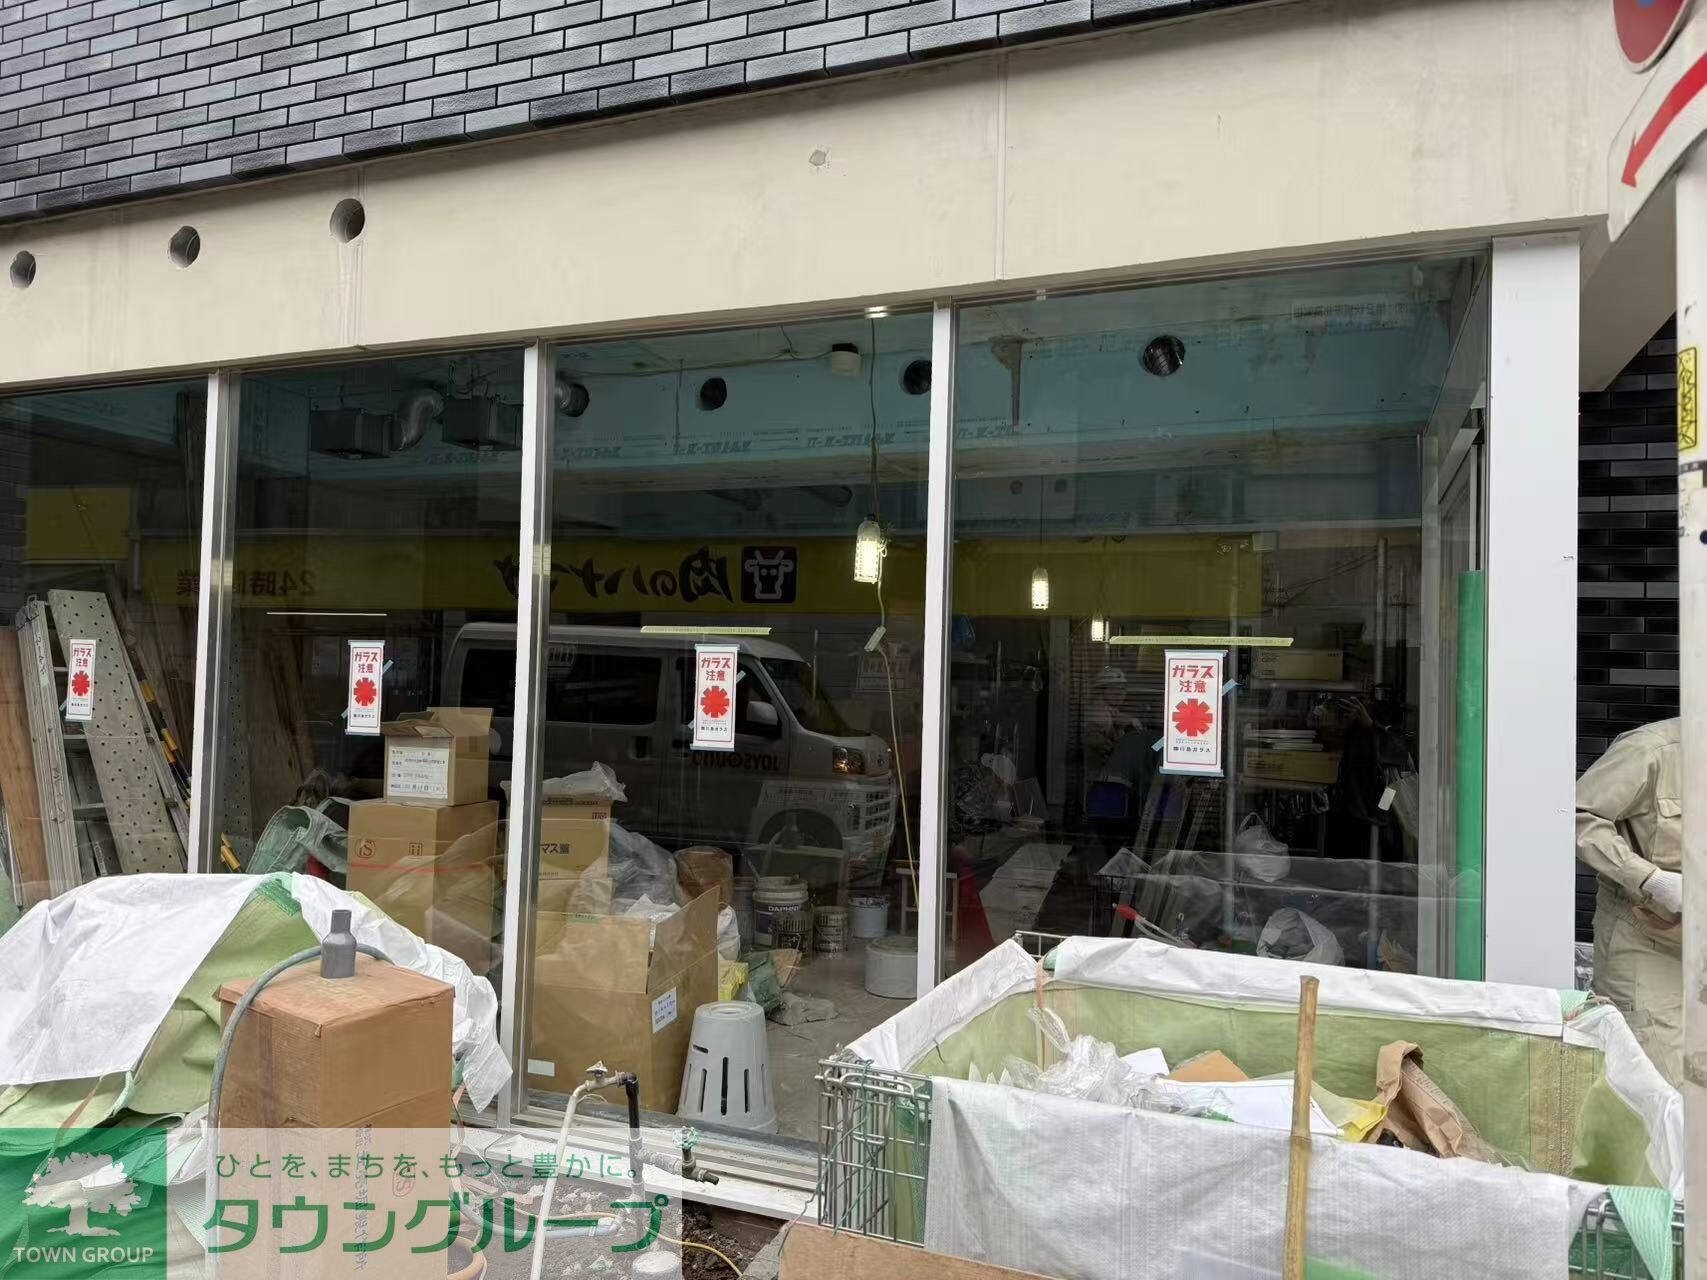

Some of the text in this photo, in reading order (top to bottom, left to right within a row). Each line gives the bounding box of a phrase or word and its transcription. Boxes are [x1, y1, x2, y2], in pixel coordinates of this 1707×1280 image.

[353, 651, 379, 663] ガラス
[700, 656, 732, 669] ガラス
[357, 662, 374, 674] 注意
[1171, 664, 1215, 679] ガラス
[705, 669, 727, 682] 注意
[1179, 679, 1207, 694] 注意
